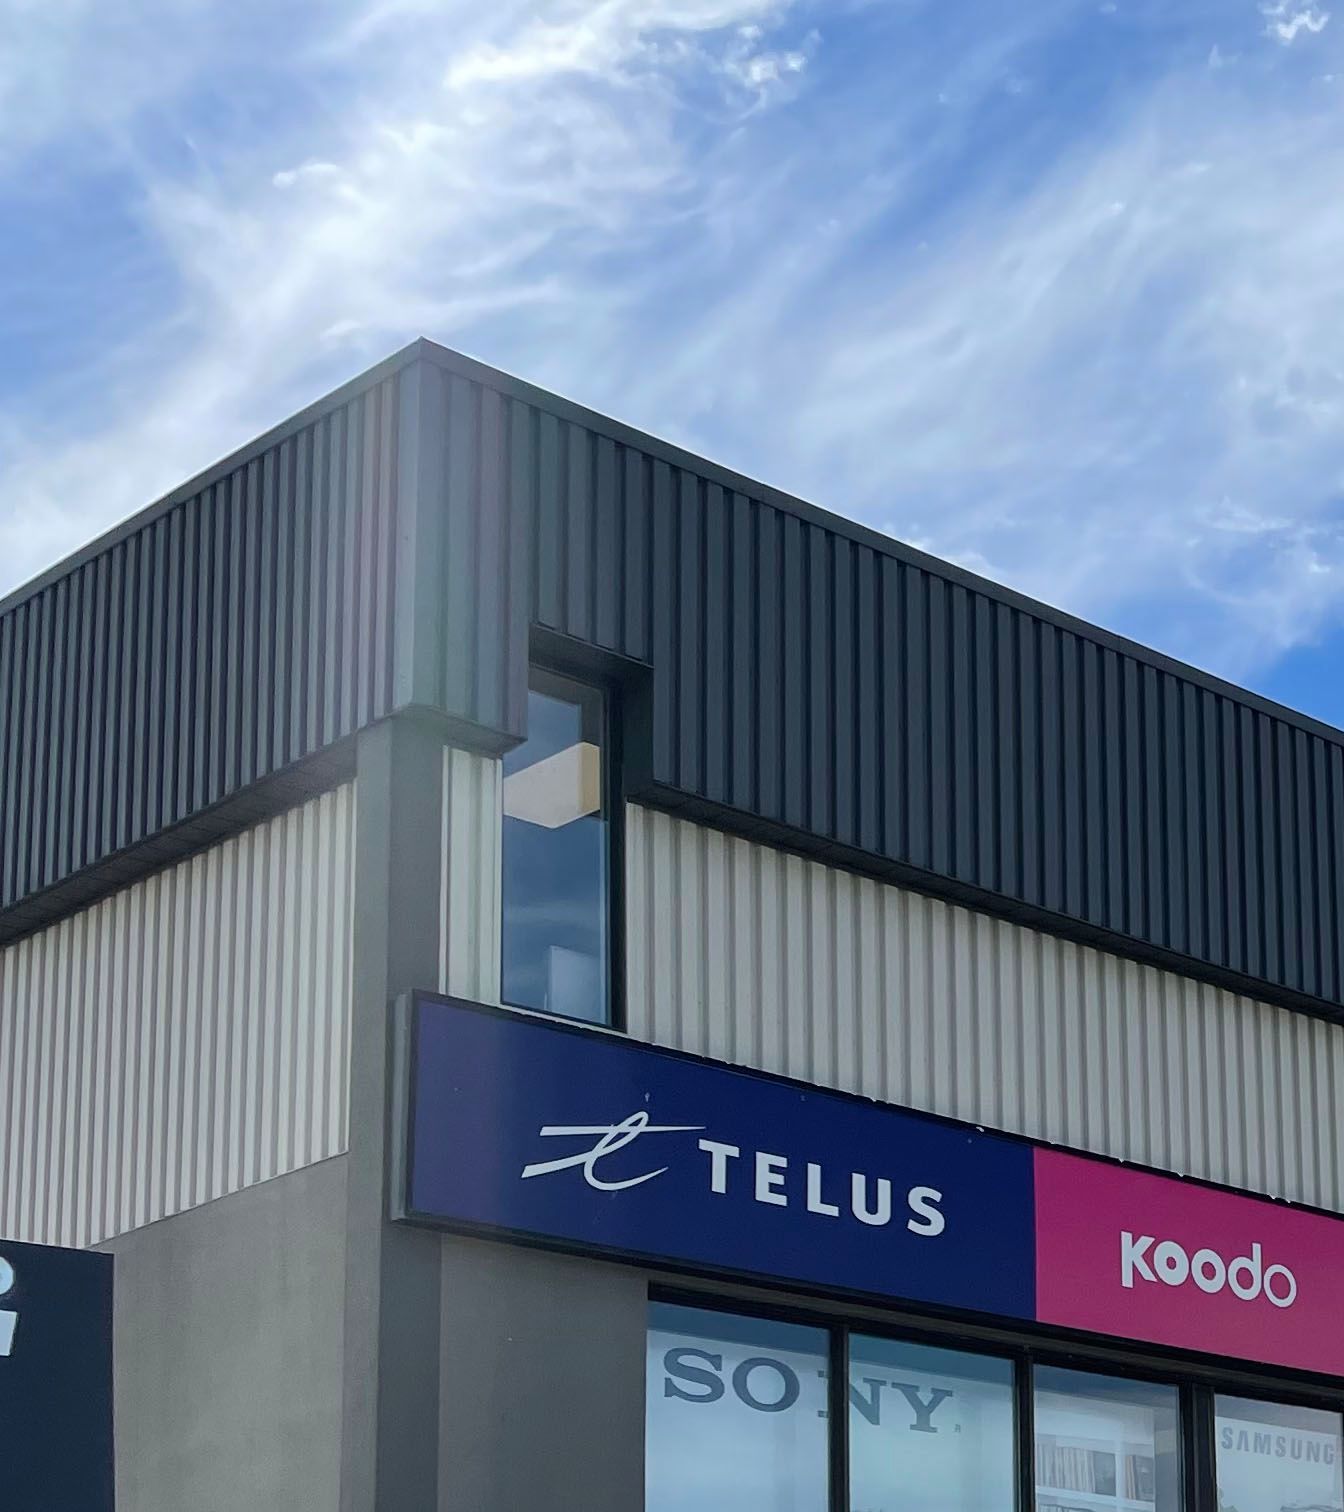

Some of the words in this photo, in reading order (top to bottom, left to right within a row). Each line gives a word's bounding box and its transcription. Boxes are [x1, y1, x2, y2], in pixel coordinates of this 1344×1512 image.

[698, 1138, 946, 1238] TELUS
[663, 1347, 953, 1433] SONY
[1221, 1426, 1334, 1465] SAMSUNG
